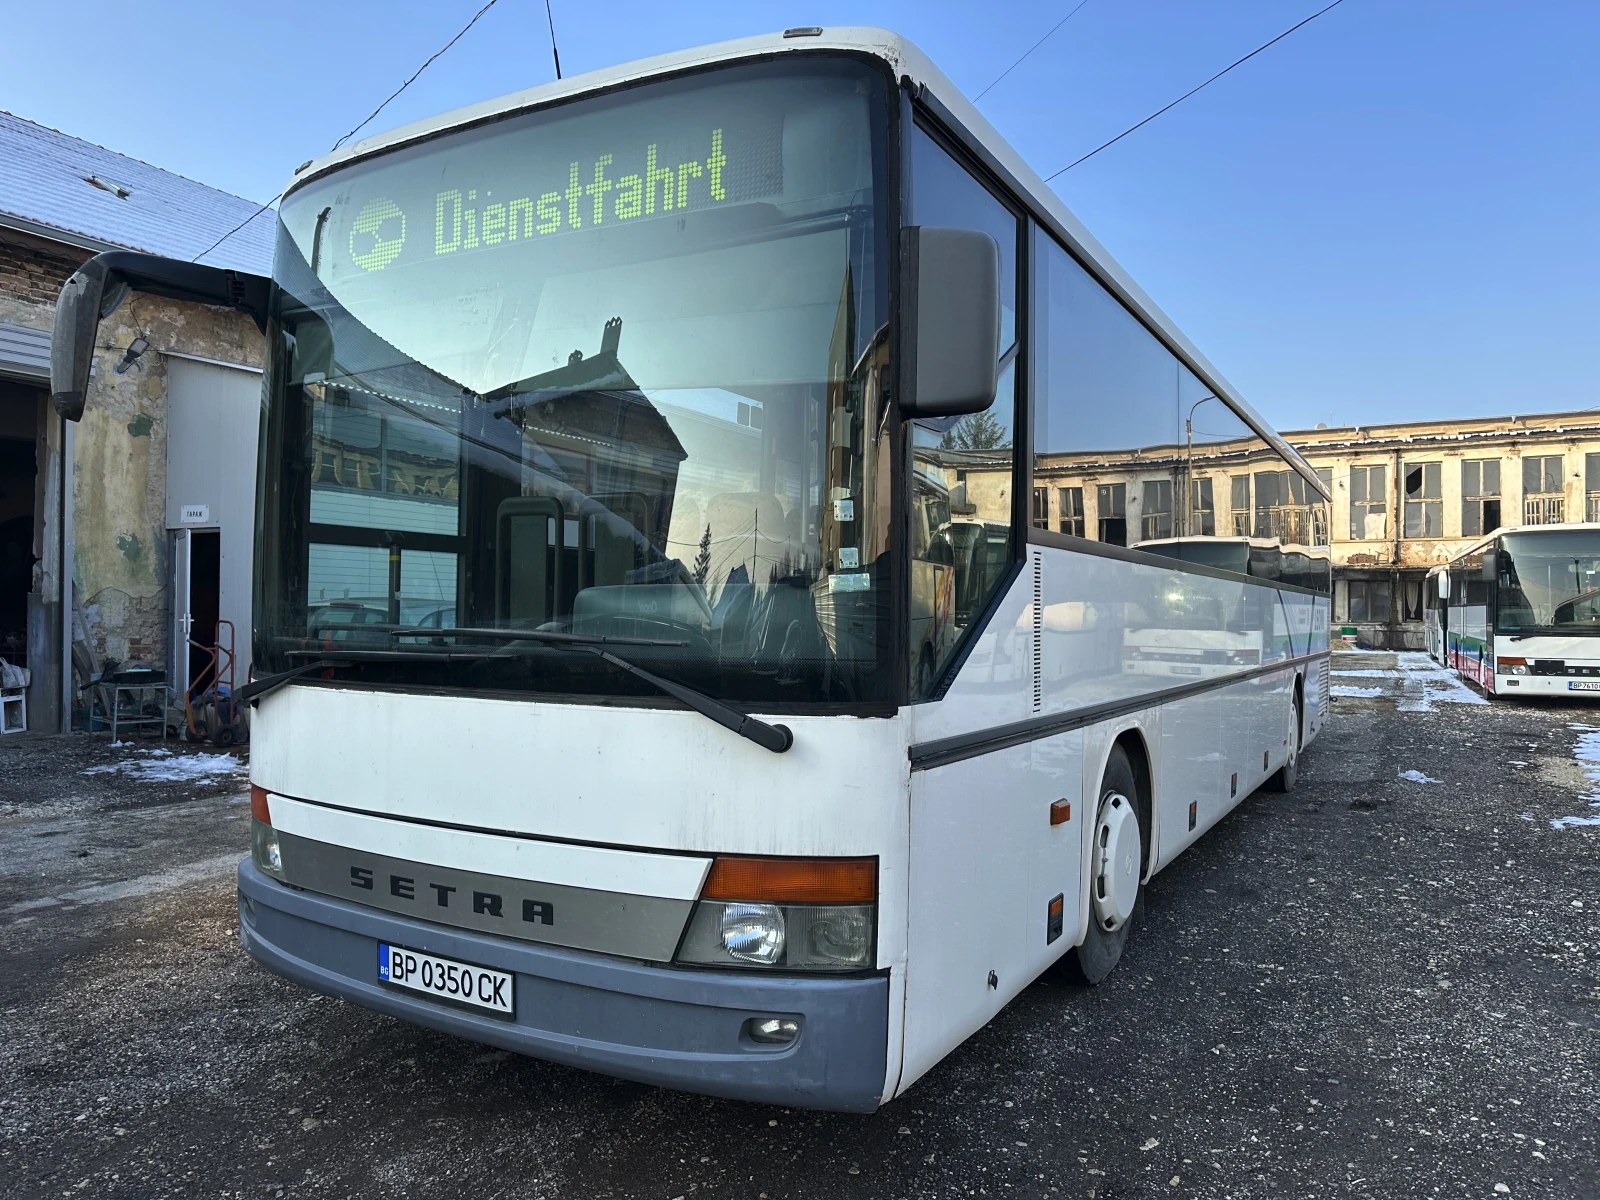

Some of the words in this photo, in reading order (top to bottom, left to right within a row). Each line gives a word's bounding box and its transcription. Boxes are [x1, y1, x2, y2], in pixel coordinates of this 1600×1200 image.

[435, 128, 727, 255] Dienstfahrt
[186, 510, 203, 518] ГАРАЖ
[350, 866, 554, 926] SETRA
[380, 965, 389, 976] BG
